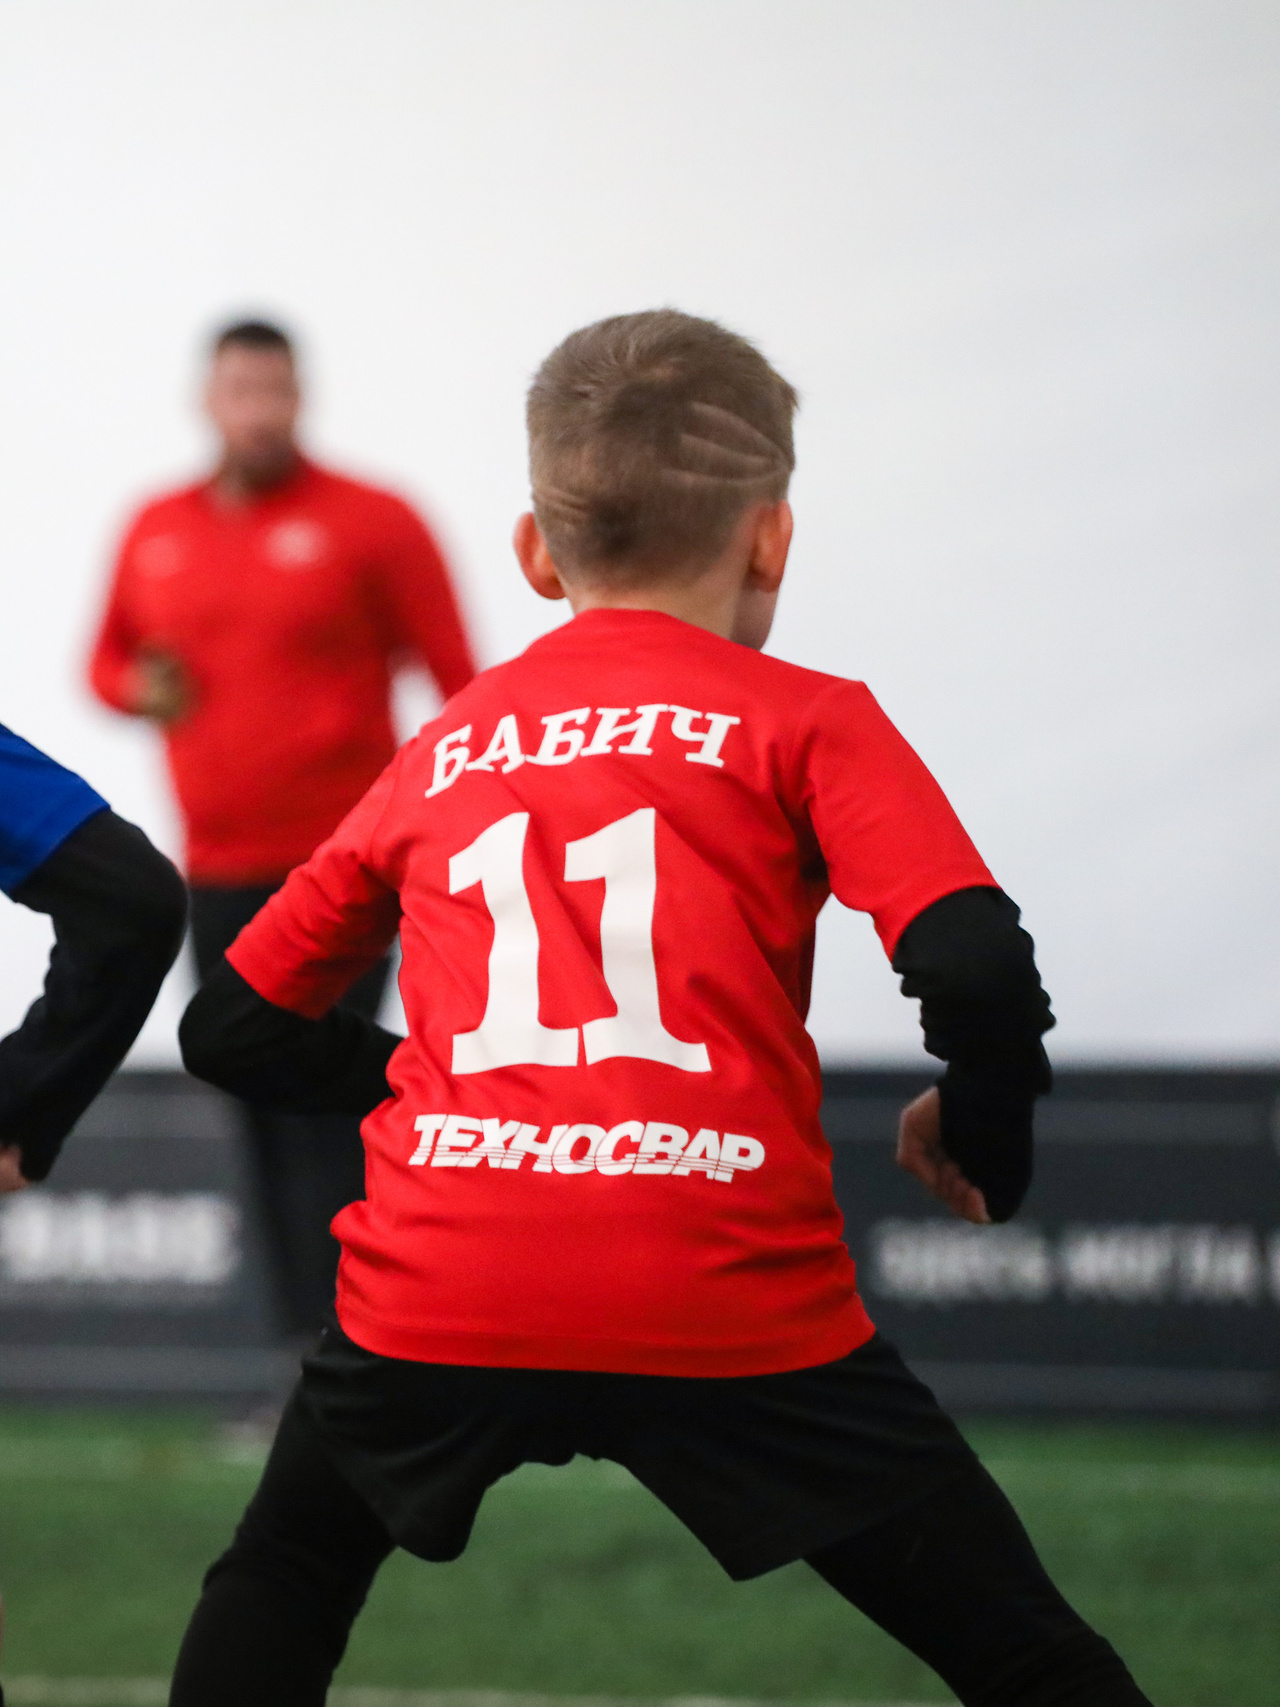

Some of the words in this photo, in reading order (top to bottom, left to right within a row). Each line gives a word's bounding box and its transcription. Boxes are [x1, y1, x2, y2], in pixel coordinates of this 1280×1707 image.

[424, 703, 742, 800] БАБИЧ
[447, 806, 713, 1076] 11
[407, 1112, 767, 1184] ТЕХНОСВАР
